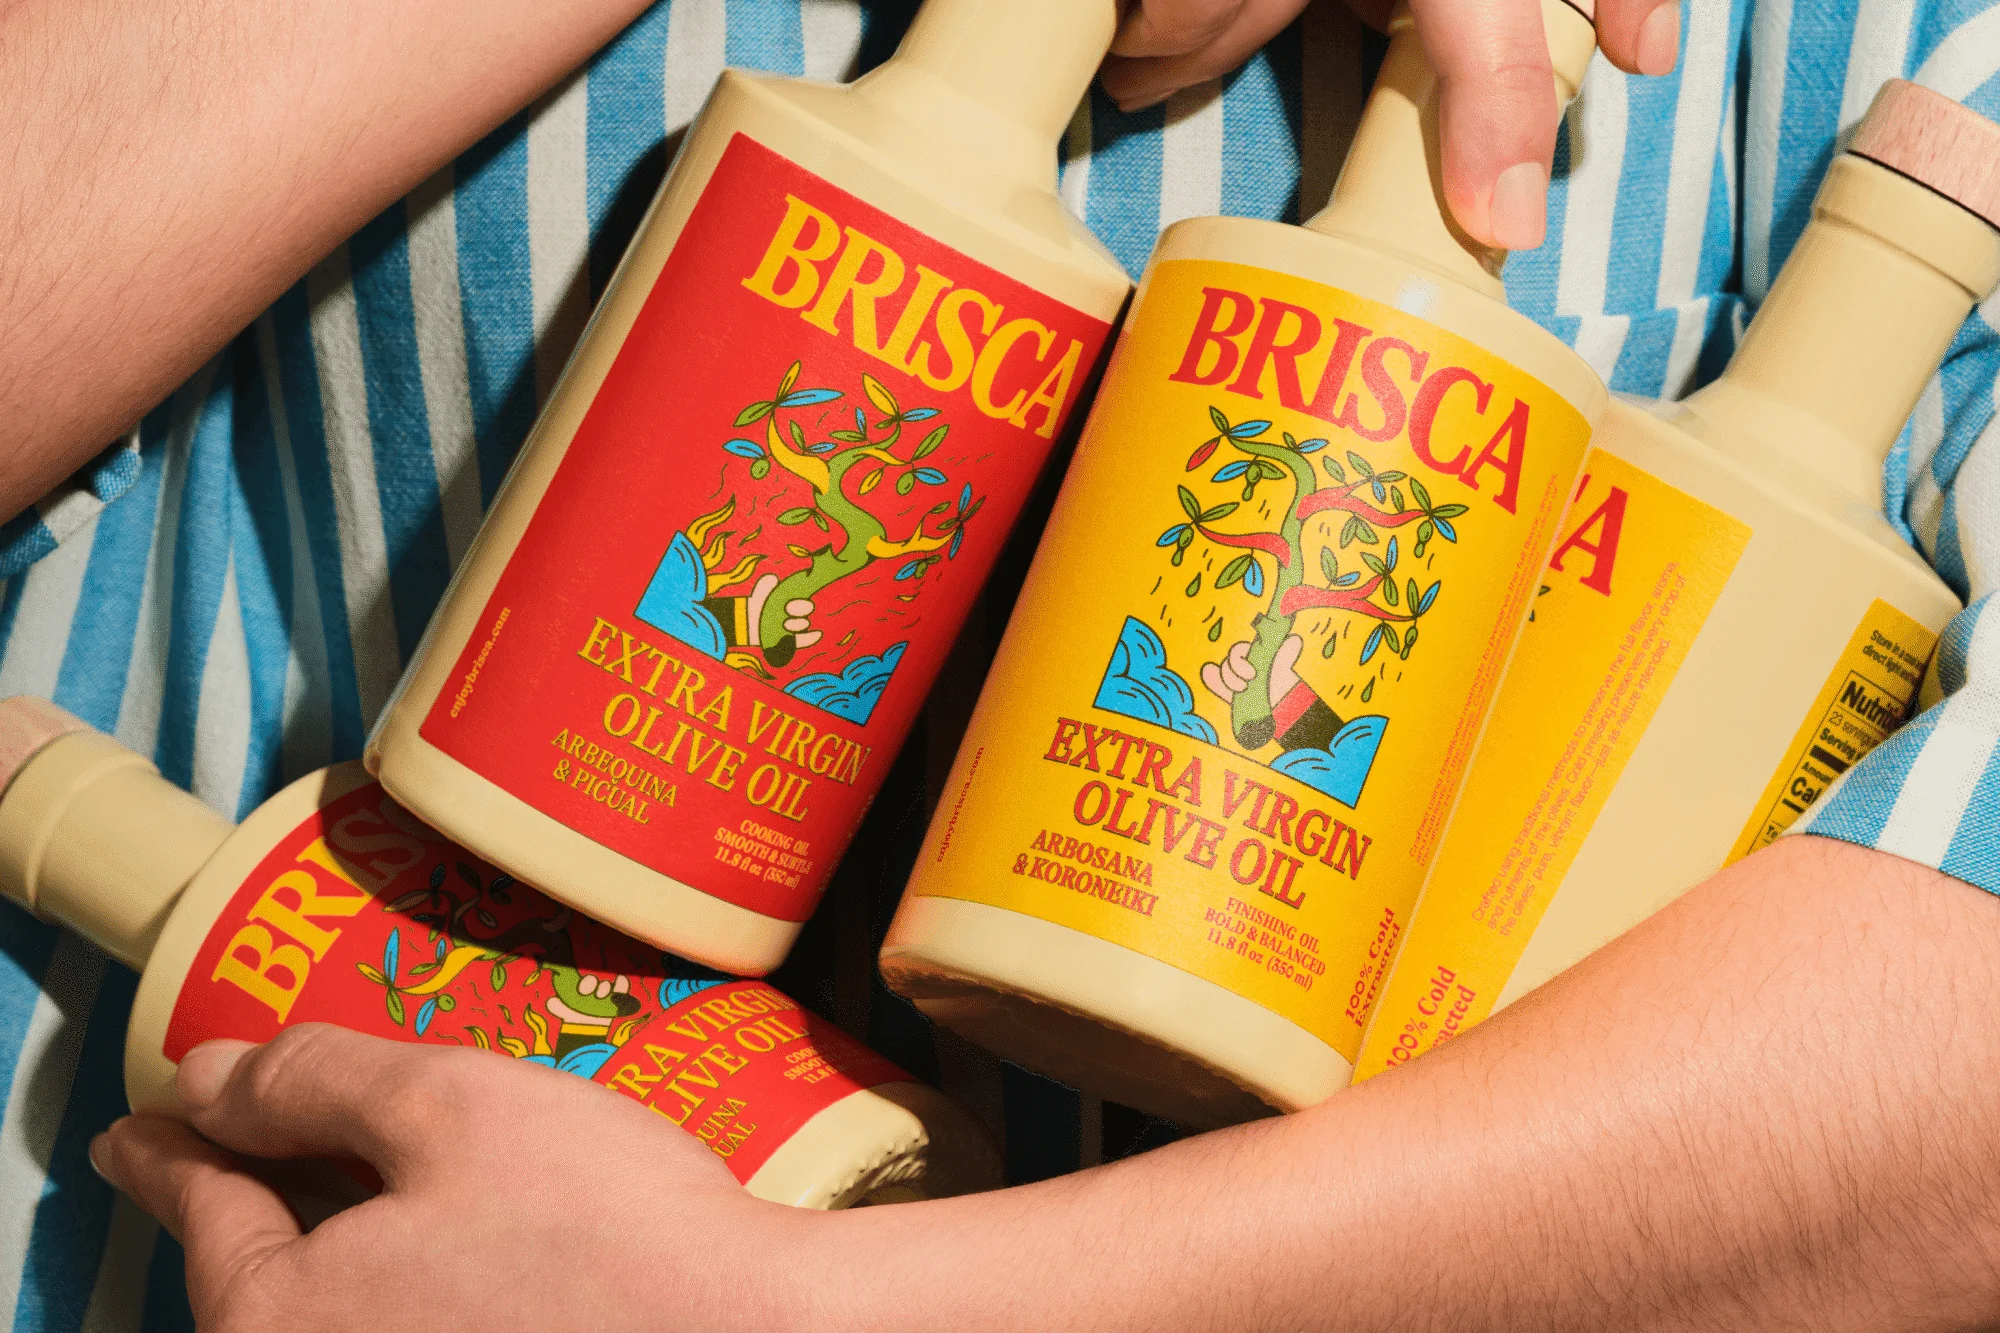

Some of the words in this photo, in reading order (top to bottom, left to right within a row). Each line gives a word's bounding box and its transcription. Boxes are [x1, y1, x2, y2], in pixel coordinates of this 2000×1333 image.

[741, 193, 1084, 439] BRISCA
[1168, 286, 1531, 515] BRISCA
[1549, 473, 1629, 597] A
[450, 607, 511, 718] enjoybrisca.com
[1862, 645, 1888, 668] direct
[1871, 629, 1893, 650] Store
[577, 616, 734, 733] EXTRA
[746, 700, 873, 786] VIRGIN
[1409, 811, 1429, 856] Crafted
[1427, 778, 1442, 809] using
[1440, 716, 1464, 775] traditional
[1483, 648, 1489, 660] to
[1488, 593, 1511, 646] preserve
[1509, 571, 1517, 590] the
[1517, 551, 1525, 568] full
[1471, 878, 1501, 921] Crafted
[1497, 846, 1521, 878] using
[1513, 790, 1550, 845] traditional
[1544, 738, 1578, 789] methods
[1573, 724, 1586, 737] to
[1581, 674, 1615, 725] preserve
[1609, 653, 1625, 672] the
[1619, 634, 1635, 652] full
[1650, 559, 1678, 599] aroma,
[1485, 906, 1503, 928] and
[1498, 855, 1532, 905] nutrients
[1526, 842, 1538, 854] of
[1534, 820, 1550, 840] the
[1565, 756, 1587, 783] Cold
[1580, 707, 1615, 756] pressing
[1608, 650, 1646, 706] preserves
[1640, 618, 1664, 650] every
[1658, 588, 1679, 616] drop
[1673, 574, 1686, 588] of
[1819, 728, 1856, 759] Serving
[1828, 710, 1842, 728] 23
[551, 728, 678, 808] ARBEQUINA
[552, 759, 571, 782] &
[571, 768, 650, 824] PICUAL
[603, 692, 748, 792] OLIVE
[746, 763, 812, 822] OIL
[937, 747, 984, 862] enjoybrisca.com
[1043, 717, 1202, 807] EXTRA
[1221, 769, 1373, 881] VIRGIN
[1499, 916, 1516, 936] the
[1531, 850, 1555, 880] pure,
[1547, 809, 1575, 848] vibrant
[1606, 727, 1620, 743] as
[1614, 690, 1641, 727] nature
[1635, 637, 1670, 690] intended.
[714, 827, 771, 860] SMOOTH
[768, 849, 779, 863] &
[777, 853, 813, 875] SUBTLE
[714, 846, 742, 867] 11.8
[739, 857, 752, 871] fl
[749, 864, 763, 876] oz
[763, 866, 787, 884] (350
[740, 819, 794, 850] COOKING
[793, 840, 810, 856] OIL
[1012, 852, 1029, 875] &
[1030, 856, 1159, 917] KORONEIKI
[1030, 829, 1154, 888] ARBOSANA
[1073, 779, 1227, 870] OLIVE
[1229, 837, 1306, 910] OIL
[1204, 907, 1246, 935] BOLD
[1246, 925, 1258, 942] &
[1259, 931, 1326, 976] BALANCED
[1207, 928, 1237, 950] 11.8
[1236, 941, 1249, 957] fl
[1248, 950, 1264, 965] oz
[1266, 955, 1294, 979] (350
[1294, 973, 1313, 993] ml)
[1225, 897, 1298, 940] FINISHING
[1299, 933, 1320, 954] OIL
[1345, 963, 1373, 1020] 100%
[1369, 907, 1395, 959] Cold
[1354, 923, 1401, 1028] Extracted
[605, 1043, 689, 1100] RA
[665, 988, 800, 1043] VIRGIN
[734, 1015, 811, 1053] OIL
[1386, 1017, 1428, 1068] 100%
[1417, 965, 1457, 1016] Cold
[804, 1068, 830, 1085] 11.8
